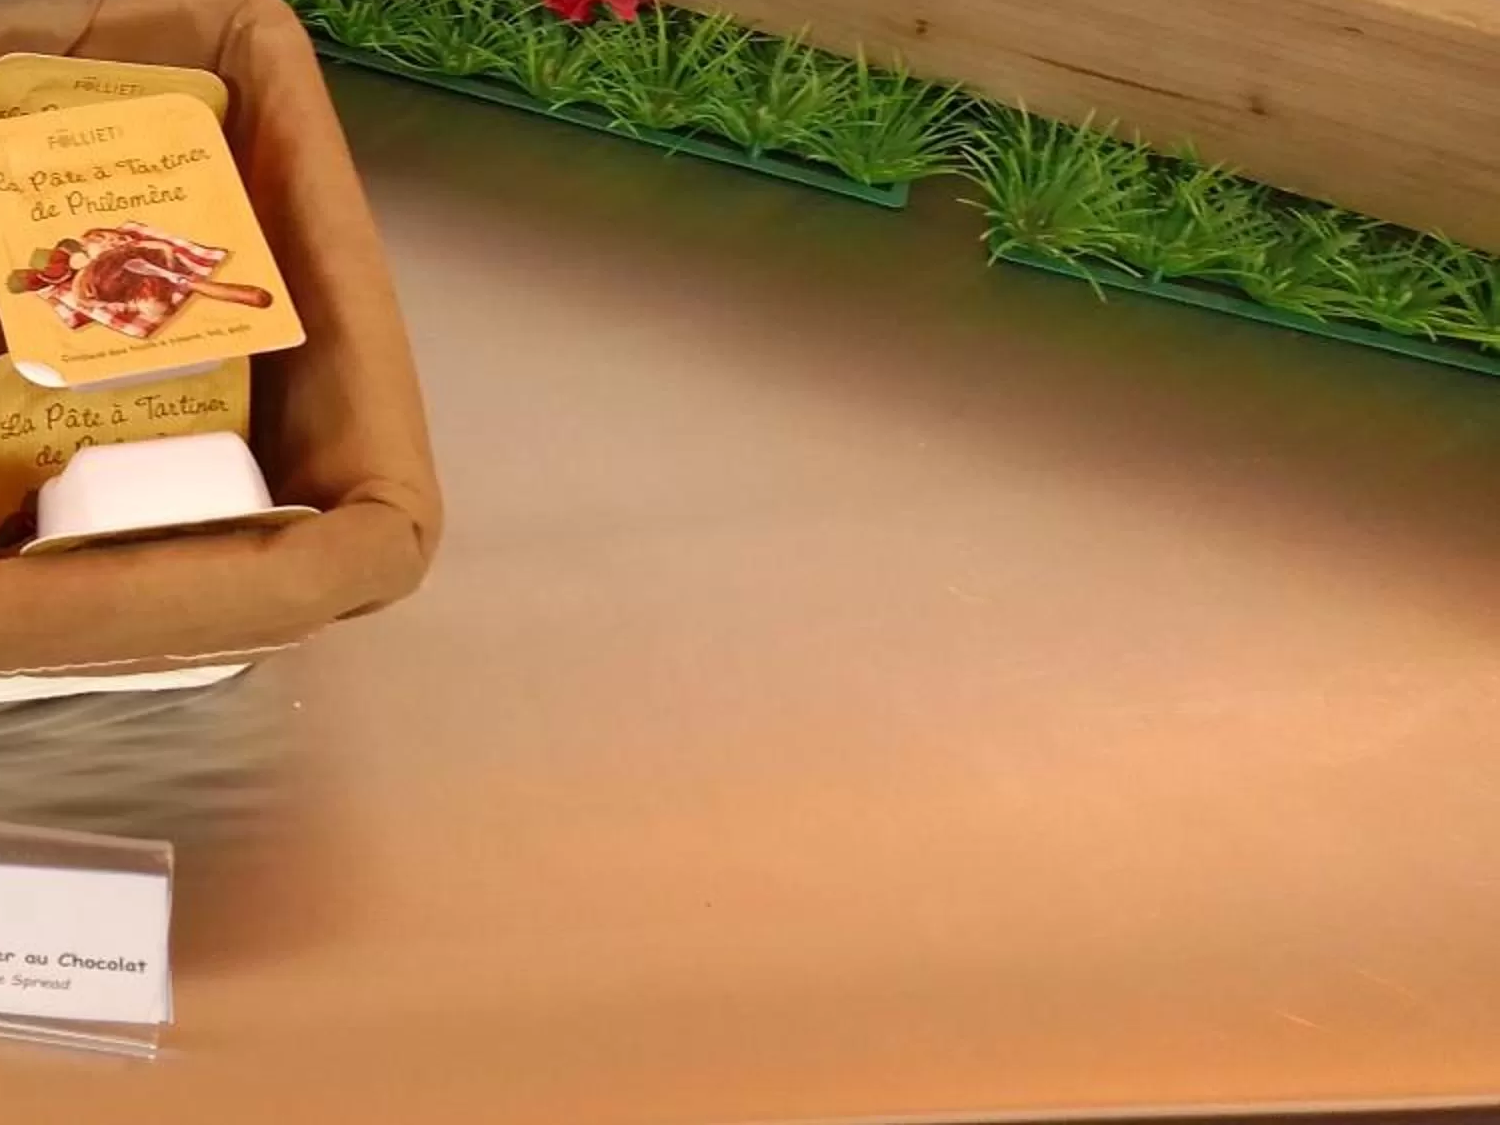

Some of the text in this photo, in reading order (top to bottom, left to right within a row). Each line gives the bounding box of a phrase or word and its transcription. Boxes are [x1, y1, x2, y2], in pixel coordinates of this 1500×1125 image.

[116, 147, 212, 176] Tartiner
[31, 185, 189, 222] de Philomène
[1, 394, 229, 440] La Pâte à Tartiner
[35, 445, 65, 467] de
[24, 955, 48, 966] au
[57, 952, 148, 973] Chocolat
[12, 974, 72, 990] Spread
